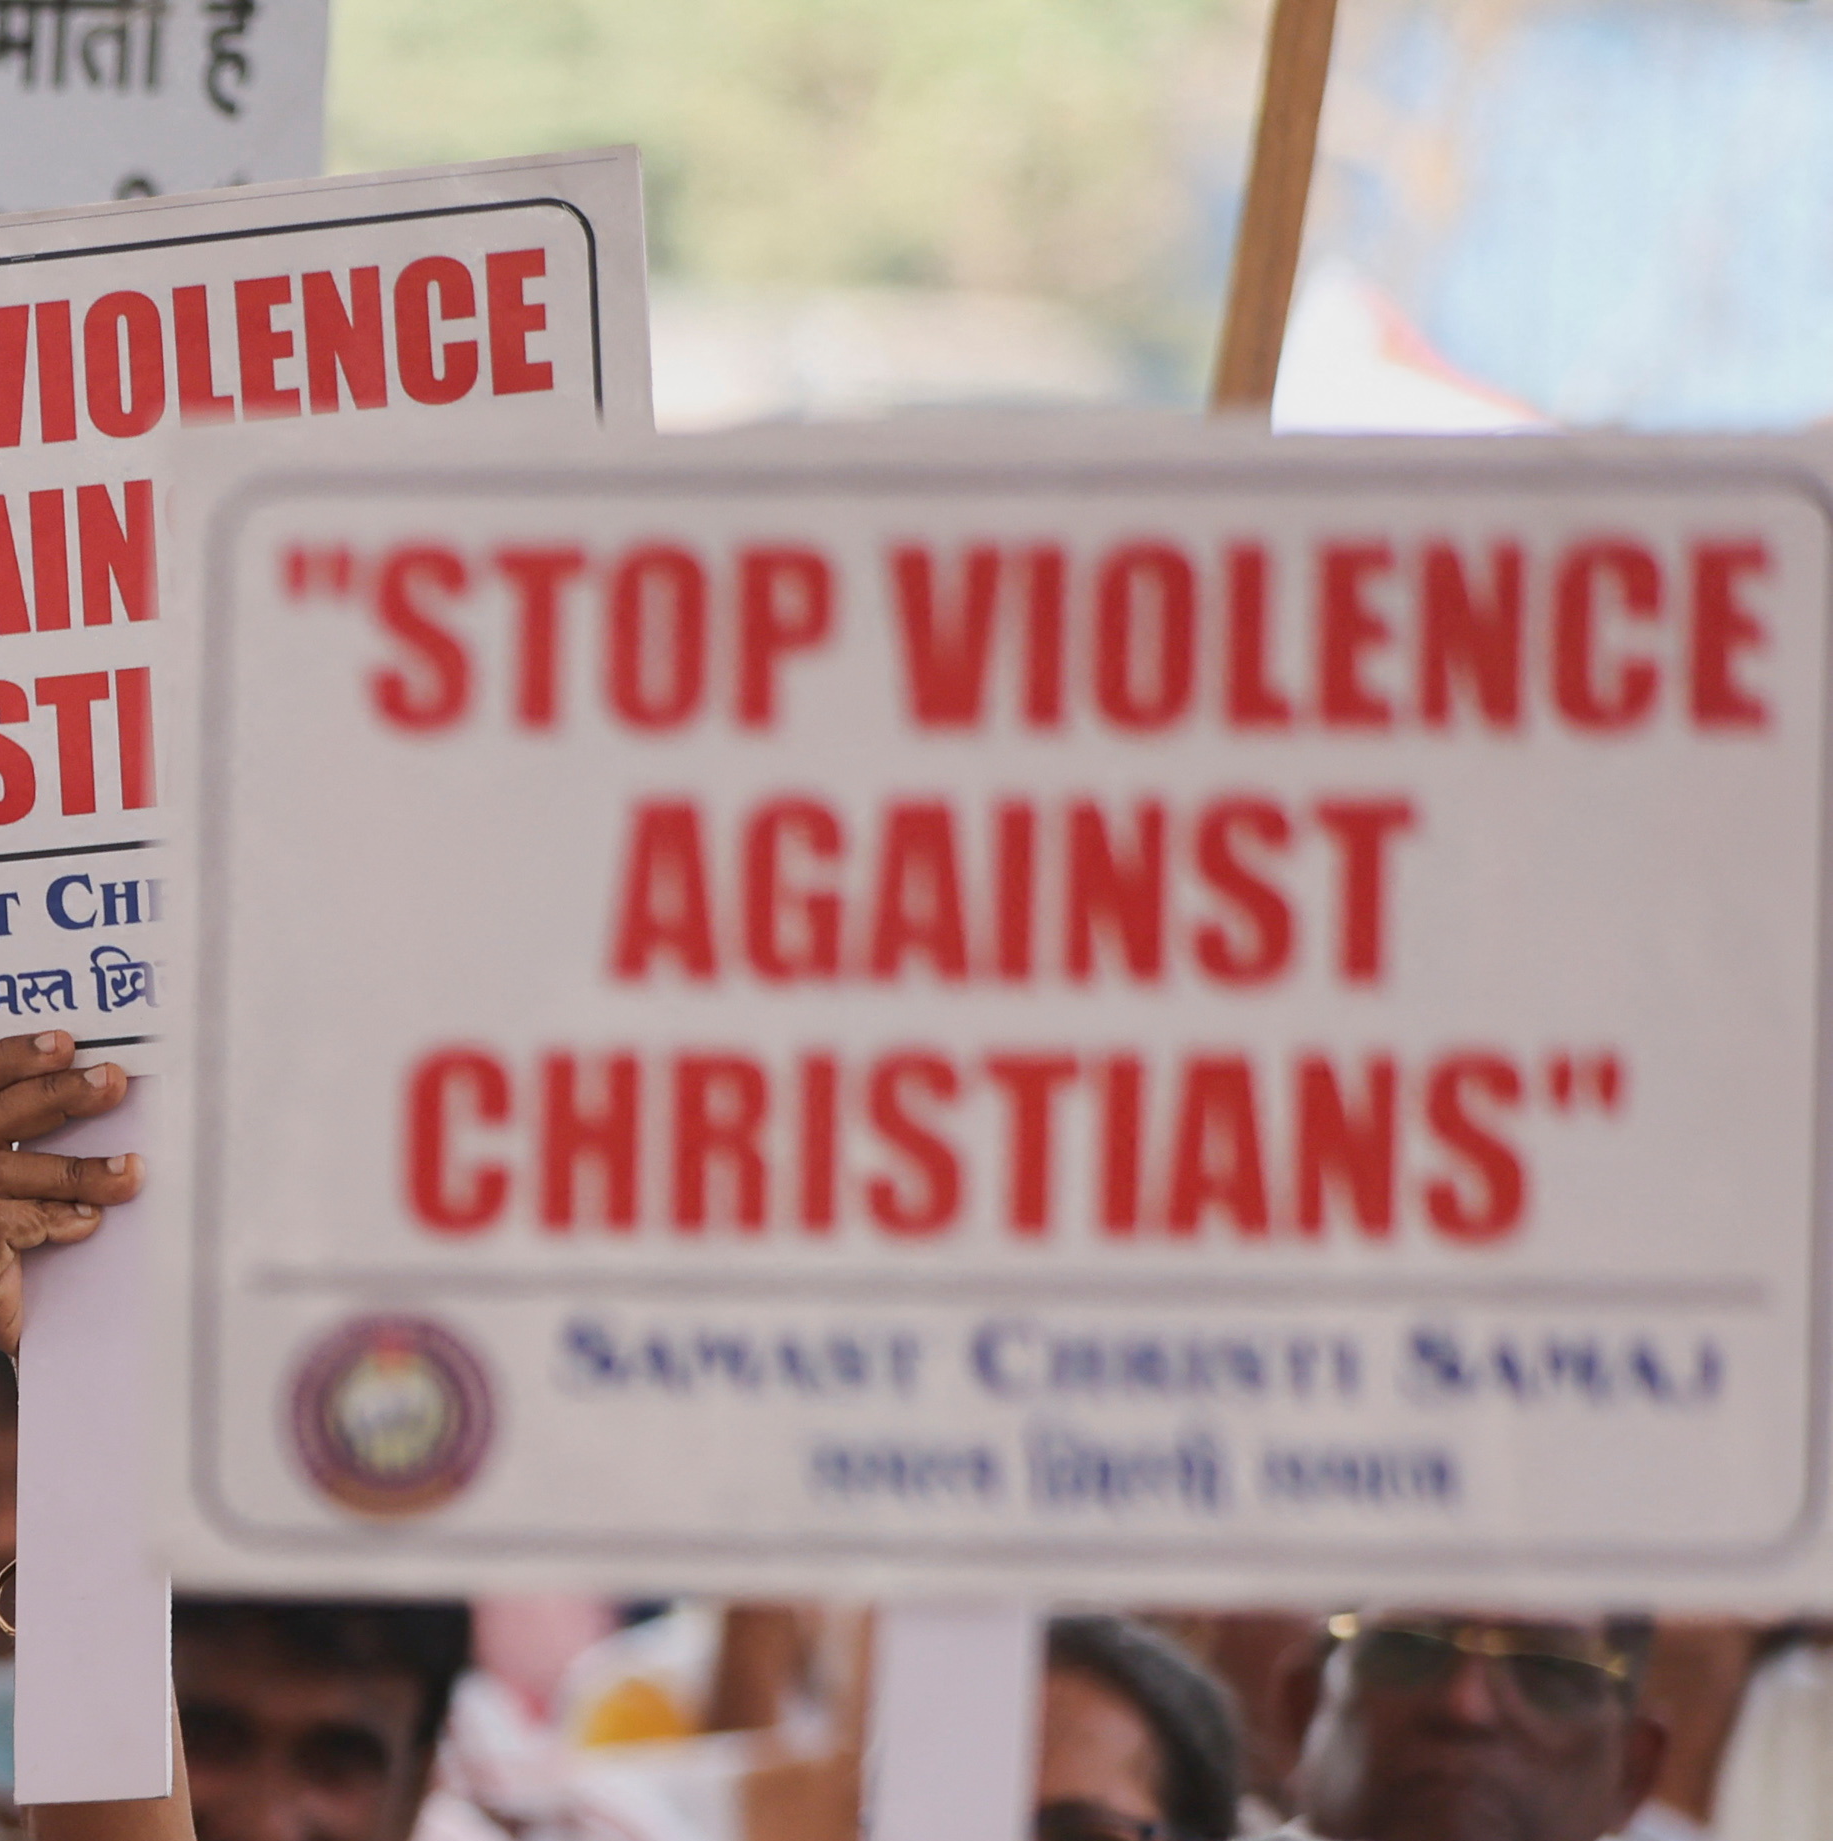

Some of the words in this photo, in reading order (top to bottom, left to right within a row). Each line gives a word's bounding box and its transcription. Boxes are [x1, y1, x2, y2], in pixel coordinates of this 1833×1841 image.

[278, 536, 844, 740] "STOP
[884, 530, 1775, 741] VIOLENCE
[604, 788, 1423, 996] AGAINST
[398, 1040, 1629, 1251] CHRISTIANS"
